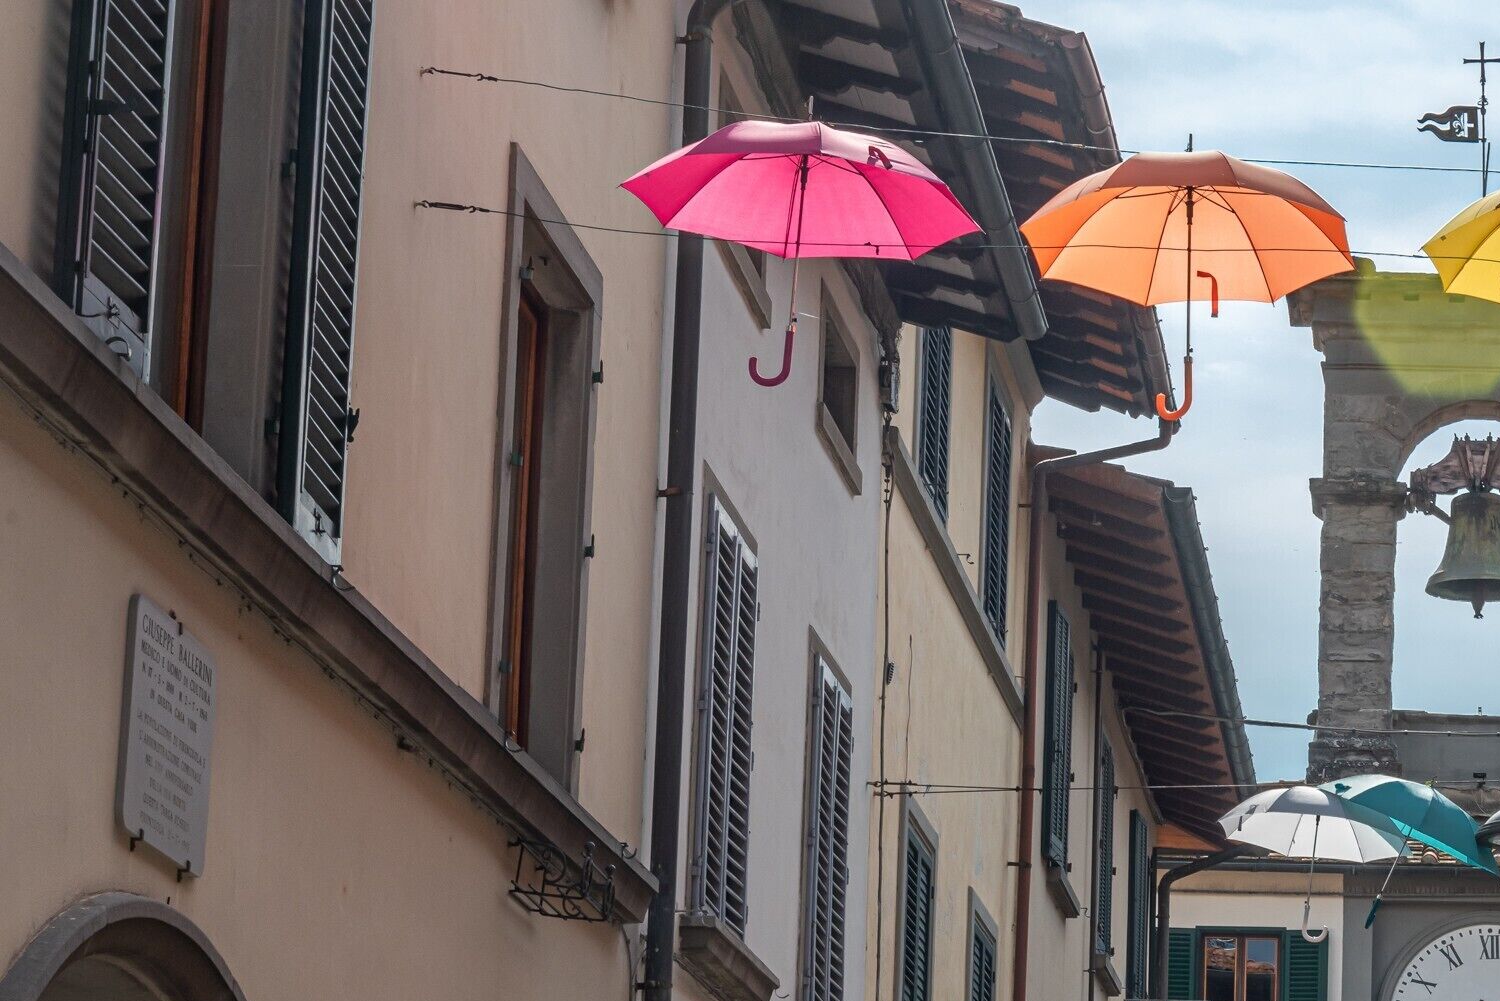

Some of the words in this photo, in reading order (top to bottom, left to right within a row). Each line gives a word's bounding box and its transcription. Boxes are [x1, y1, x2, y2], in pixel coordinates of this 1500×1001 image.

[142, 614, 174, 654] GIUSEPPE
[179, 645, 212, 685] BALLERINI
[141, 641, 160, 664] MEDICO
[167, 662, 182, 681] UOMO
[190, 680, 210, 704] CULTURA
[158, 695, 172, 713] QUESTA
[1439, 943, 1464, 971] XI
[1479, 934, 1500, 960] XII
[1411, 972, 1437, 995] X
